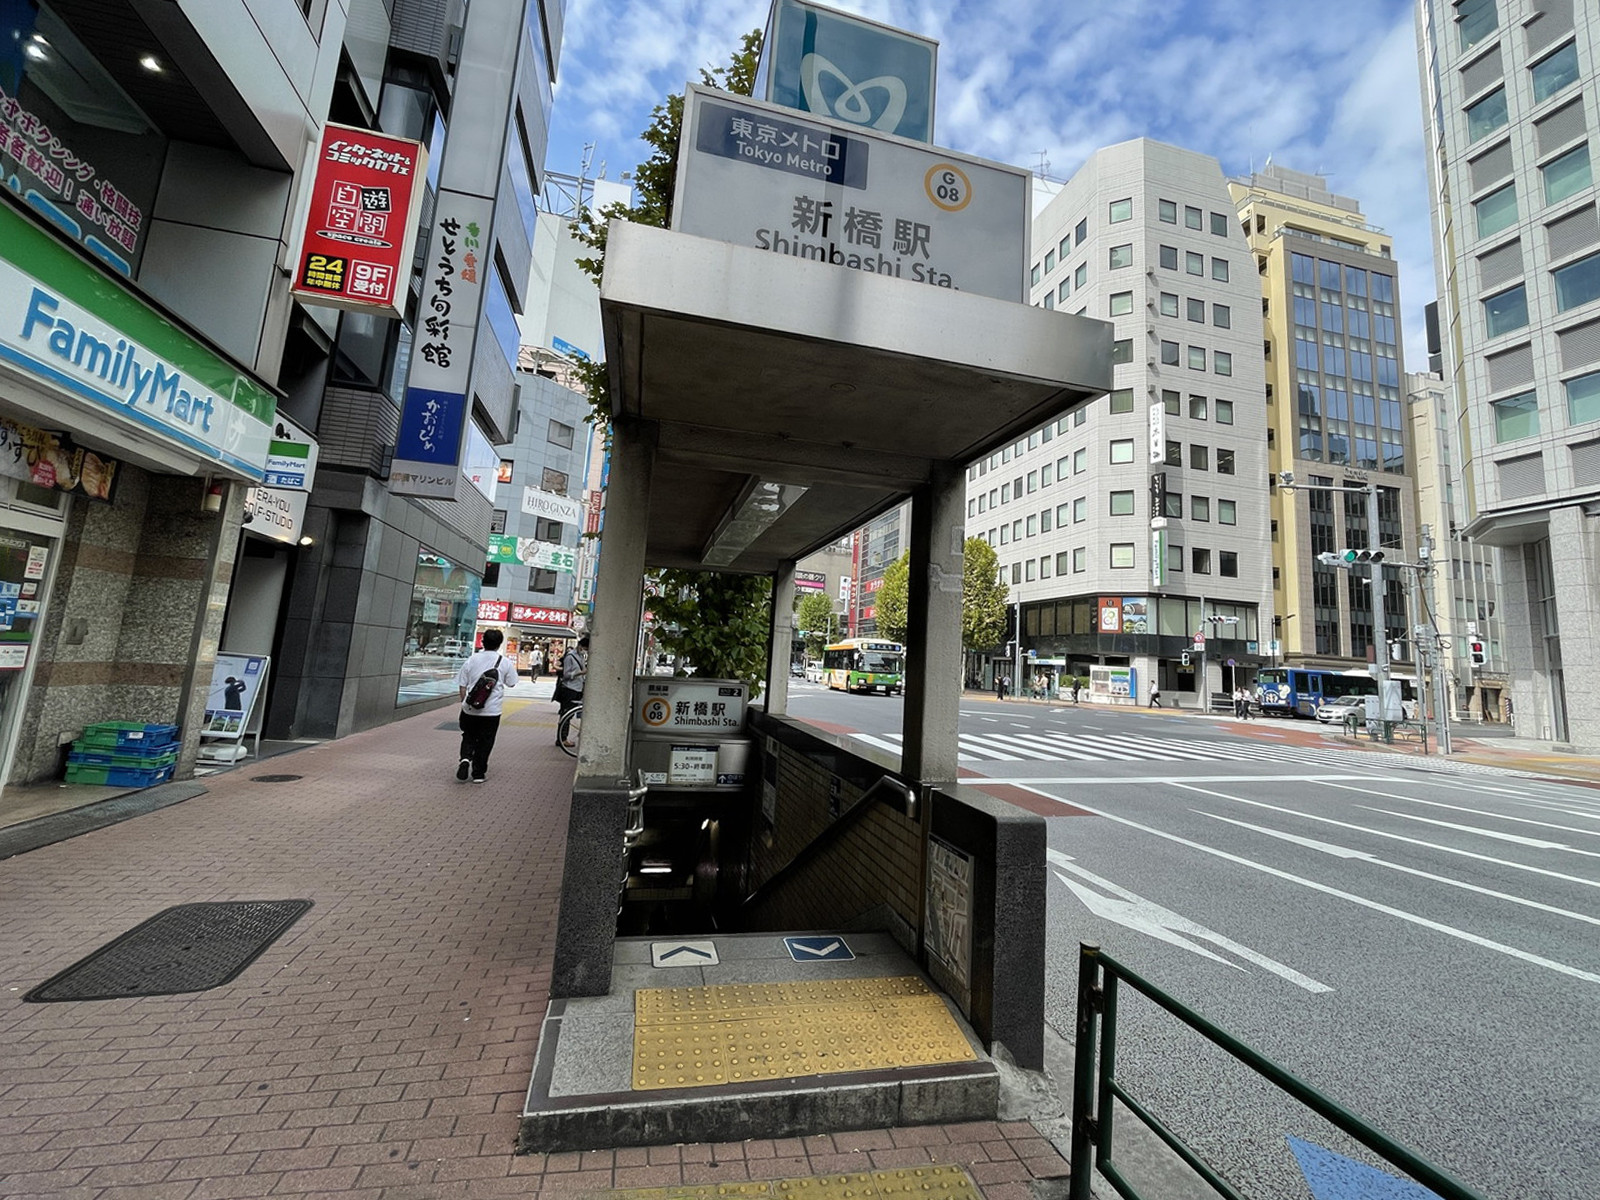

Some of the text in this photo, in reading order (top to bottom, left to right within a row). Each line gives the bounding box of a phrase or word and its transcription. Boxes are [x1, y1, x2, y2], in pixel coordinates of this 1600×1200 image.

[730, 117, 840, 160] 東京メトロ
[326, 150, 410, 176] コミックカフェ
[736, 140, 833, 176] Tokyo Metro
[942, 171, 956, 185] G
[936, 185, 960, 202] 08
[791, 195, 932, 260] 新橋駅
[326, 232, 353, 241] space
[754, 228, 902, 277] Shimbashi
[309, 256, 344, 274] 24
[355, 266, 388, 282] 9F
[353, 280, 385, 295] 受付
[421, 217, 461, 368] せとうち旬彩館
[20, 286, 215, 434] FamilyMart
[418, 399, 441, 453] かおりひめ
[267, 458, 306, 470] FamilyMart
[280, 475, 302, 486] たばこ
[527, 496, 550, 513] HIRO
[550, 502, 576, 518] GINZA
[551, 552, 574, 567] 宝石
[733, 688, 739, 696] 2
[653, 703, 661, 711] G
[675, 701, 726, 716] 新橋駅
[649, 711, 663, 720] 08
[674, 716, 740, 727] Shimbashi Sta.
